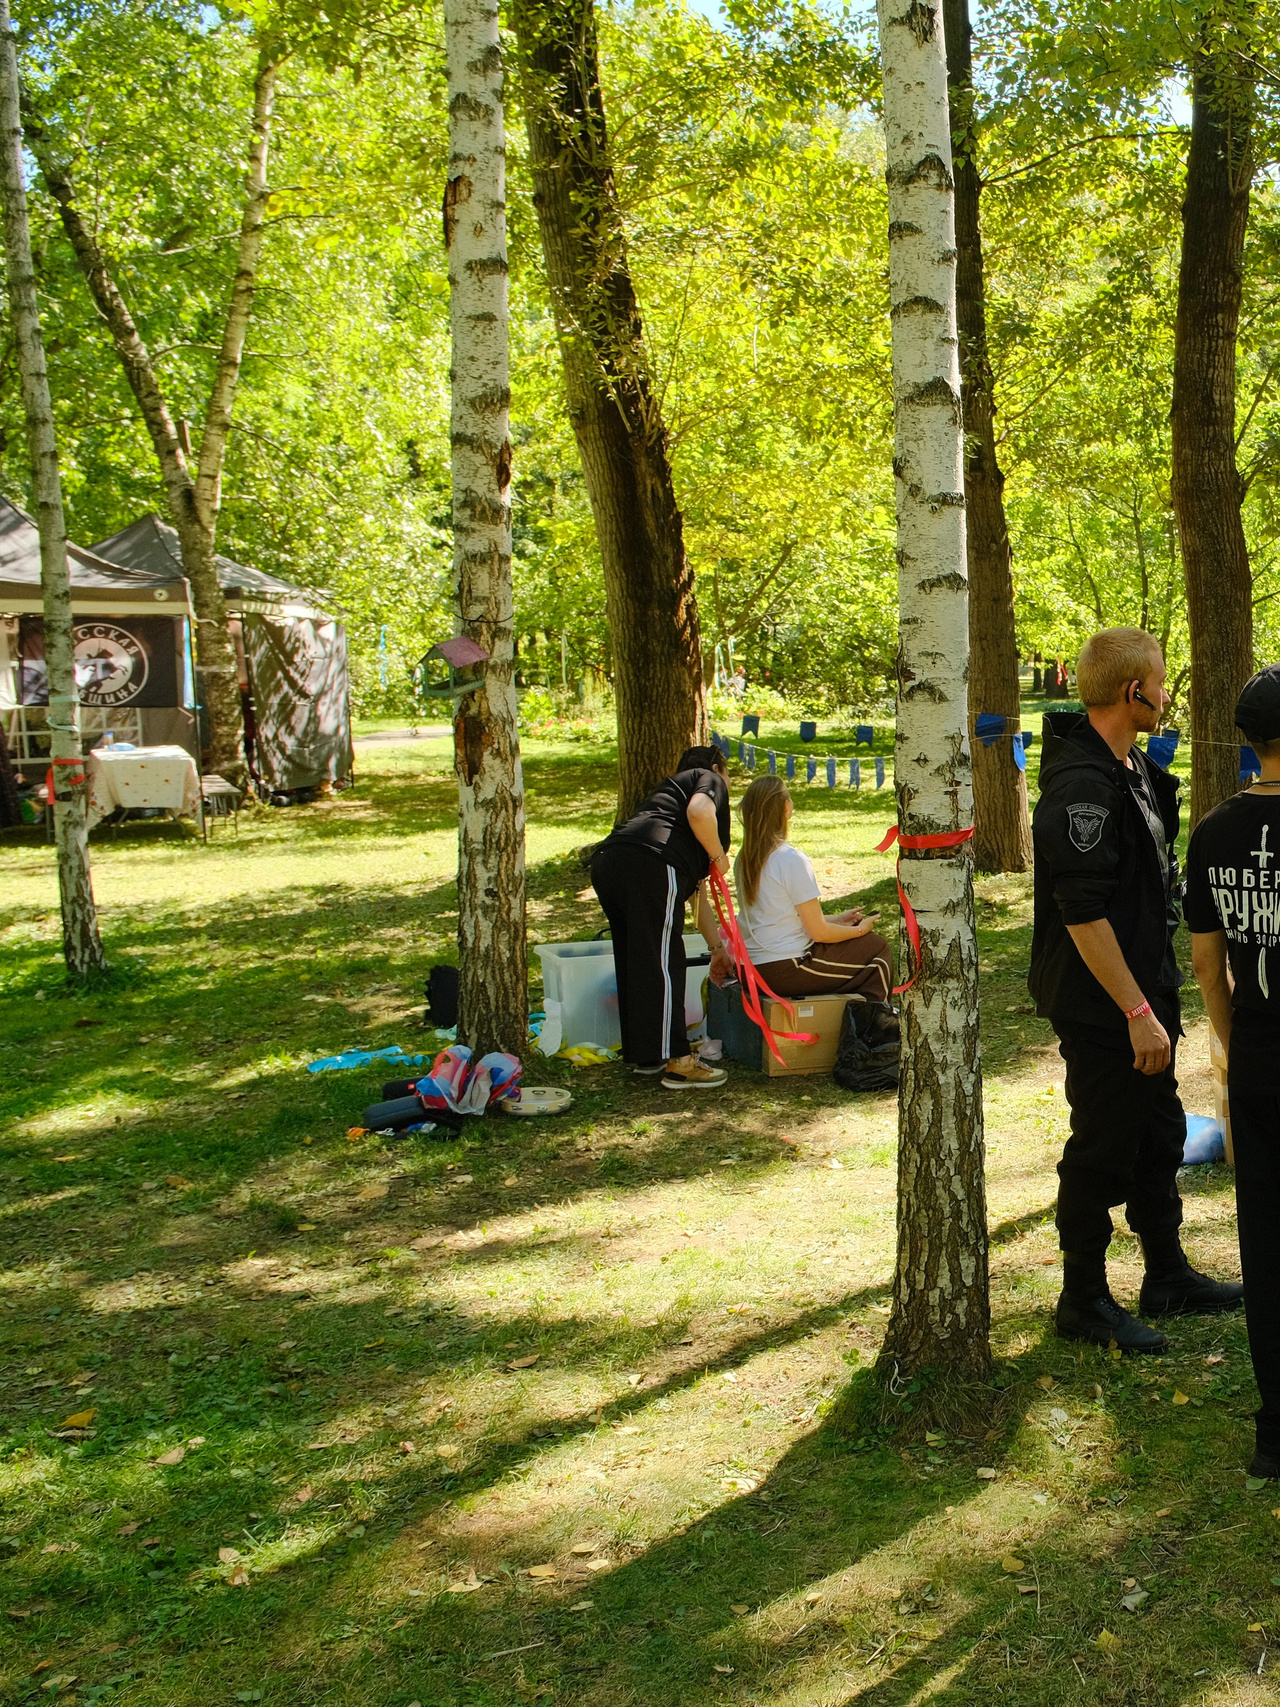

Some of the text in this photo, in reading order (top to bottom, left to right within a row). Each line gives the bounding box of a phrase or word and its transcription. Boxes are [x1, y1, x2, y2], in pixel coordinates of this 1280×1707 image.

[74, 627, 140, 655] ССКАЯ
[79, 682, 139, 704] БЩИНА
[1226, 929, 1249, 944] ЖНЬ
